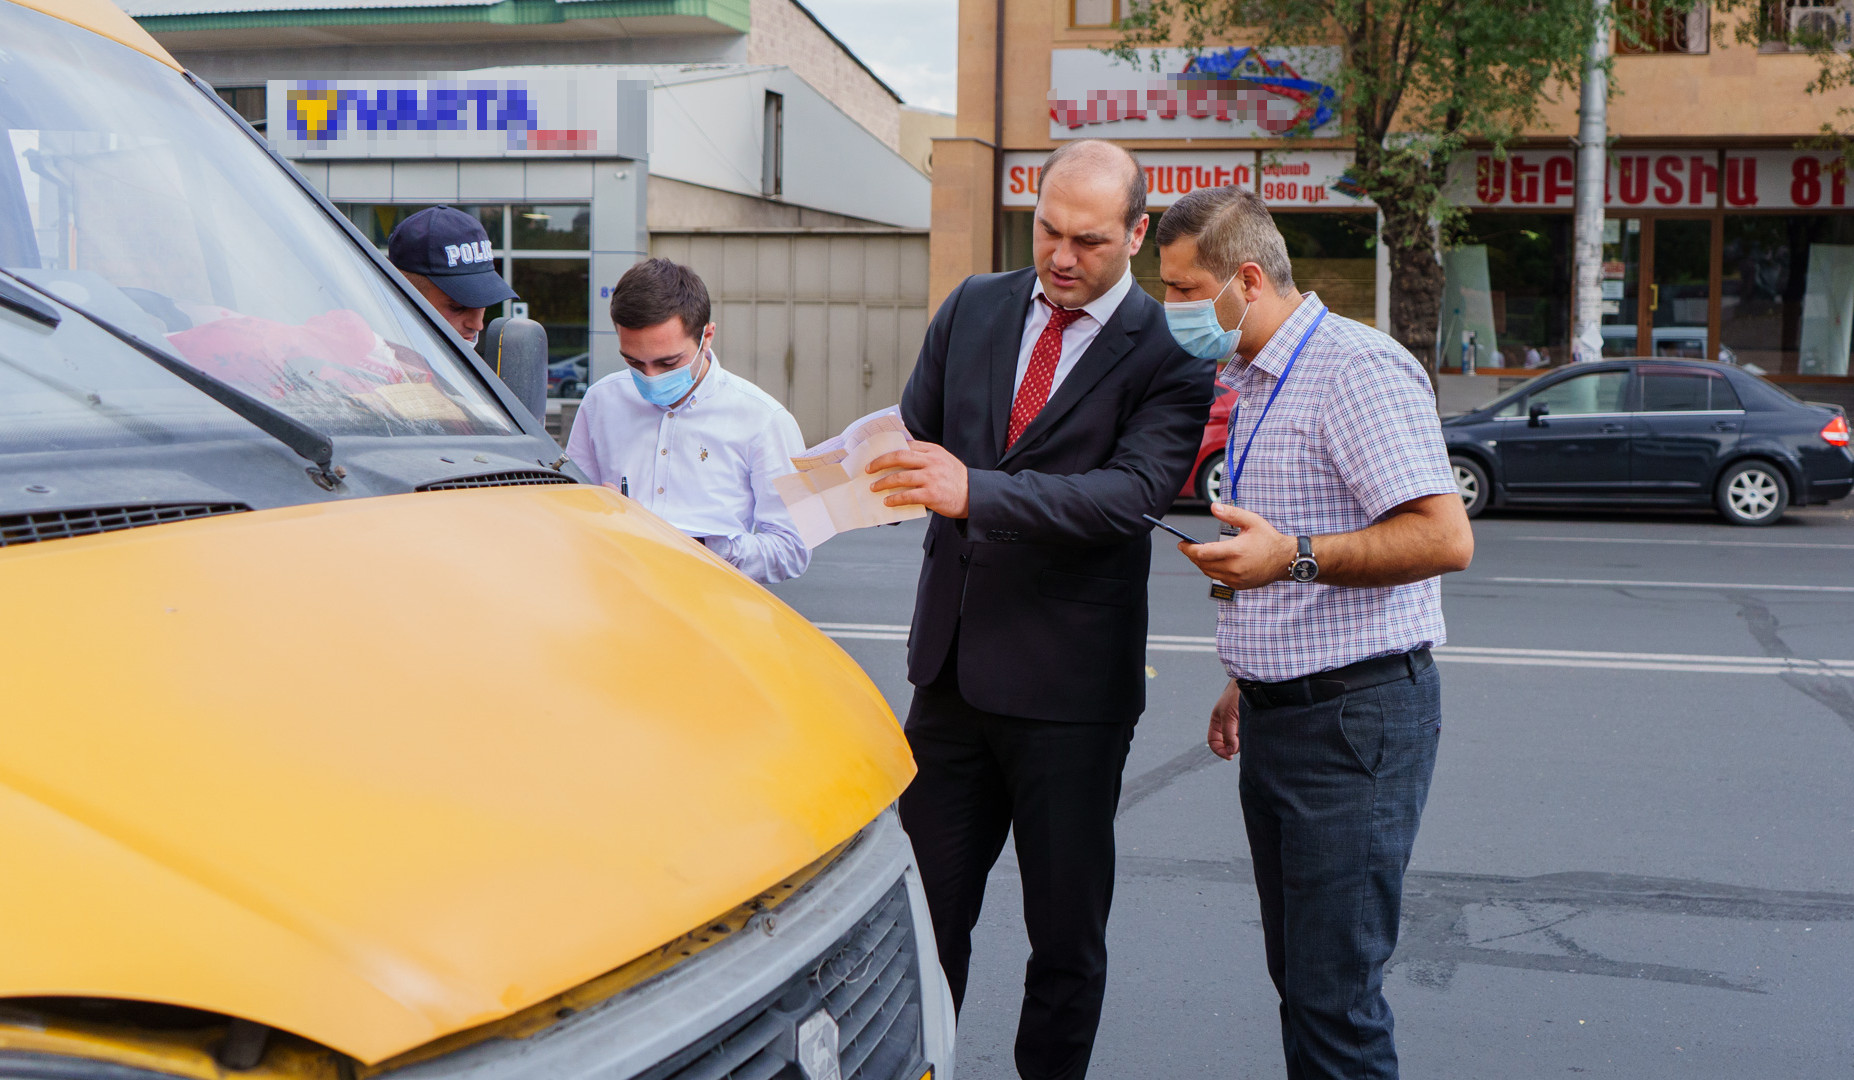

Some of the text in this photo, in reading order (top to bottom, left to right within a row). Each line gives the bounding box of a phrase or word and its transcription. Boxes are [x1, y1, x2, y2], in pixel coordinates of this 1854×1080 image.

[1264, 182, 1297, 200] 980
[1476, 155, 1847, 208] ՍԵԲՍՏԻԱ 81
